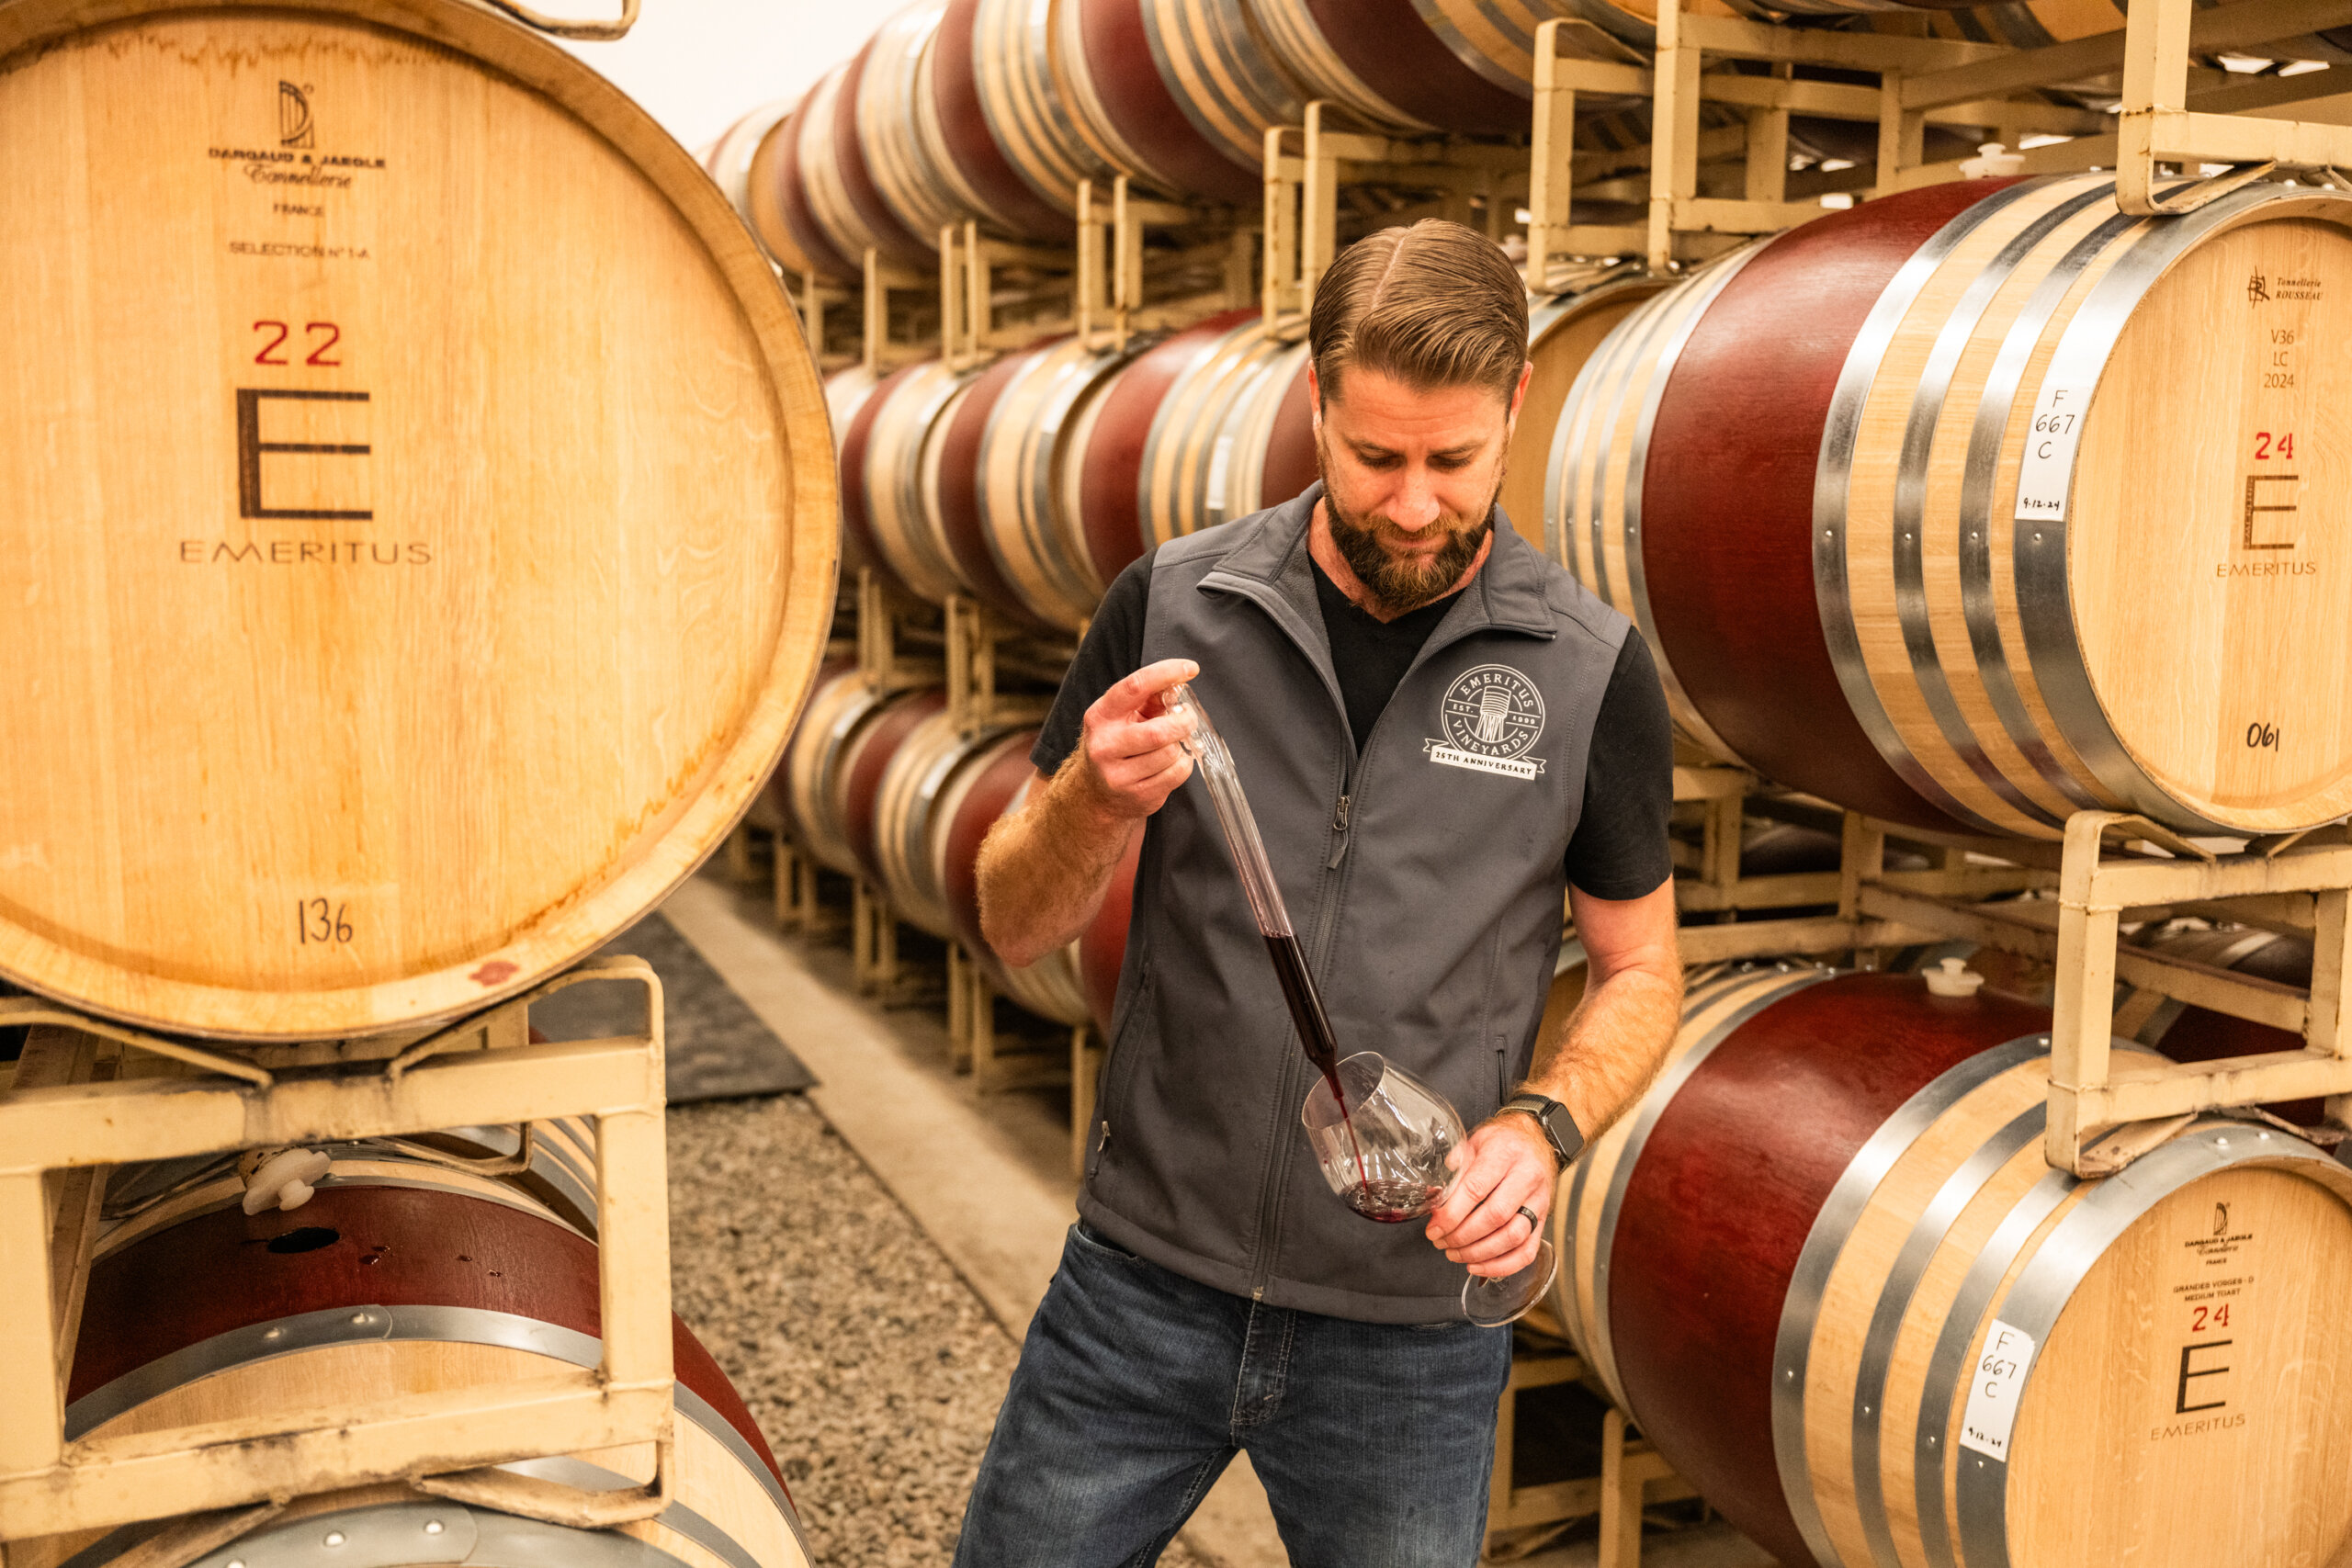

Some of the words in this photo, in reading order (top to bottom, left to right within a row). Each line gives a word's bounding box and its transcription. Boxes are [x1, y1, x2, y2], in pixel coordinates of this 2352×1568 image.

[301, 154, 312, 164] &
[273, 203, 323, 217] FRANCE
[230, 241, 324, 258] SELECTION
[2277, 277, 2322, 288] Tonnellerie
[2276, 290, 2323, 301] ROUSSEAU
[253, 320, 341, 367] 22
[2271, 329, 2295, 345] V36
[2273, 351, 2289, 367] LC
[2264, 373, 2295, 389] 2024
[2052, 389, 2069, 408] F
[2035, 413, 2075, 434] 667
[236, 388, 373, 521] E
[2038, 441, 2052, 459] C
[2255, 432, 2293, 460] 24
[2243, 475, 2299, 550] E
[179, 540, 432, 566] EMERITUS
[2216, 561, 2317, 578] EMERITUS
[1460, 673, 1534, 708] EMERITUS
[1453, 703, 1474, 714] EST.
[1453, 719, 1530, 756] VINEYARDS
[2246, 722, 2280, 752] 061
[1435, 750, 1460, 762] 25TH
[1463, 756, 1532, 774] ANNIVERSARY
[299, 897, 353, 944] 136
[2173, 1281, 2211, 1293] GRANDES
[2185, 1292, 2214, 1302] MEDIUM
[2217, 1288, 2241, 1297] TOAST
[2192, 1303, 2230, 1333] 24
[1996, 1330, 2015, 1351] F
[1982, 1354, 2017, 1380] 667
[2176, 1339, 2233, 1415] E
[1984, 1382, 1997, 1398] C
[2151, 1413, 2245, 1441] EMERITUS
